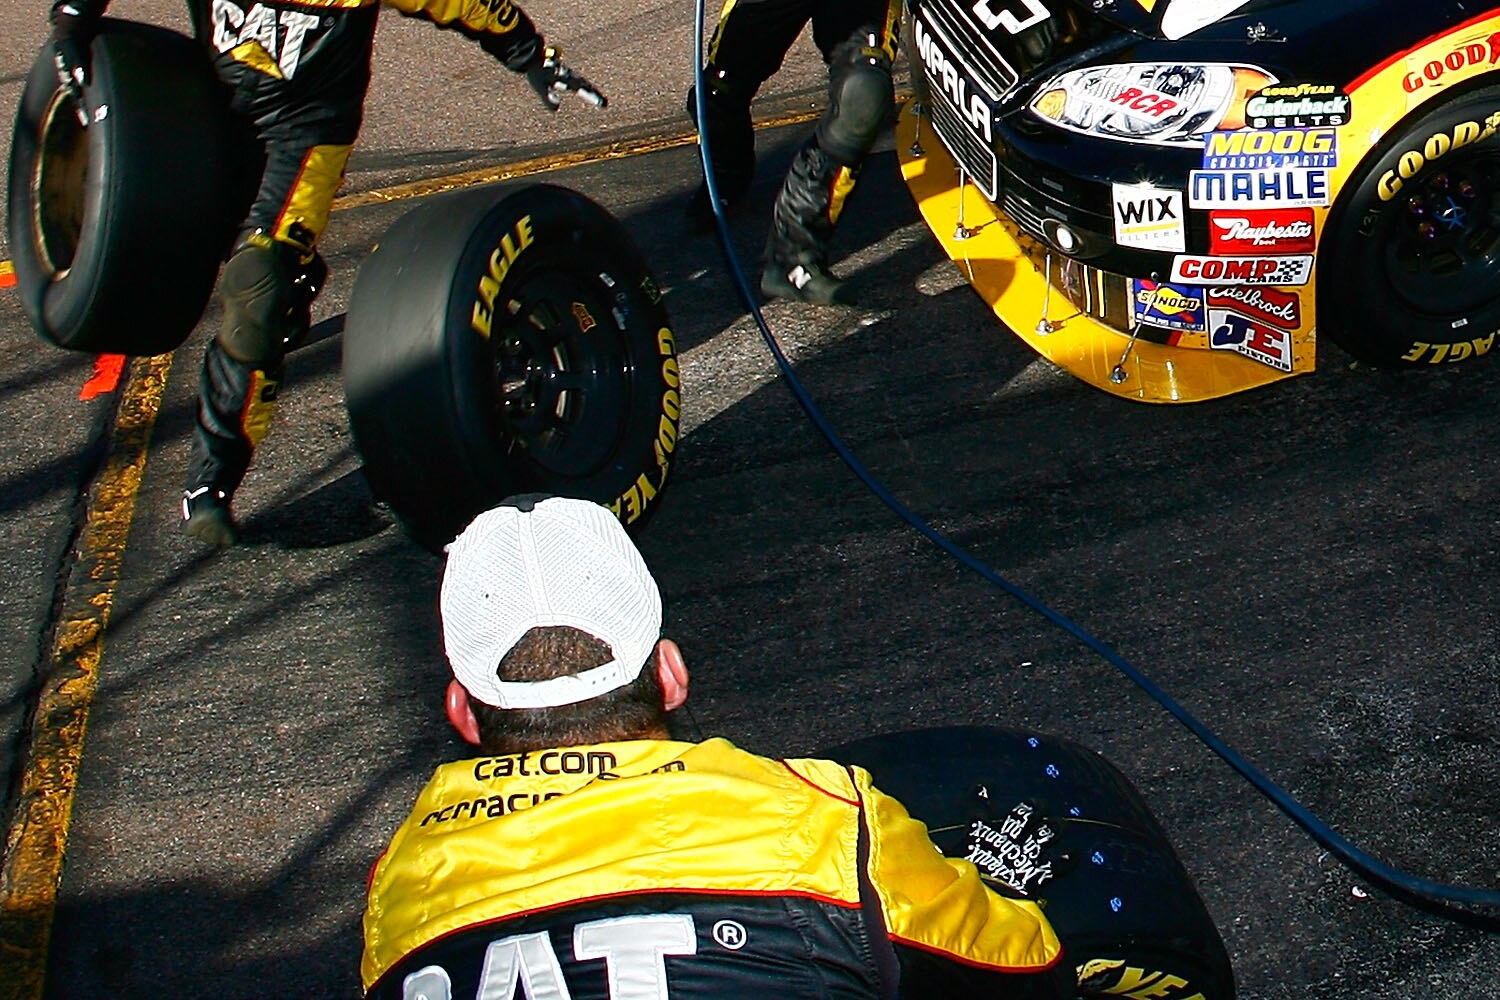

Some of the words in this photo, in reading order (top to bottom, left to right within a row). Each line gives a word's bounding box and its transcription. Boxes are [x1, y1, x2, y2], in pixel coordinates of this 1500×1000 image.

[1110, 87, 1178, 118] RCR
[1262, 84, 1335, 97] GOODYEAR
[1246, 95, 1349, 118] Gatorback
[1253, 115, 1343, 128] BELTS
[1205, 129, 1333, 157] MOOG
[1192, 170, 1326, 201] MAHLE
[1117, 195, 1177, 224] WIX
[1119, 229, 1181, 242] FILTERS
[471, 214, 536, 341] EAGLE
[1179, 259, 1278, 280] COMP
[1246, 274, 1294, 284] CAMS
[1212, 314, 1284, 360] JE
[1238, 345, 1291, 371] PISTONS
[474, 750, 617, 782] cat.com
